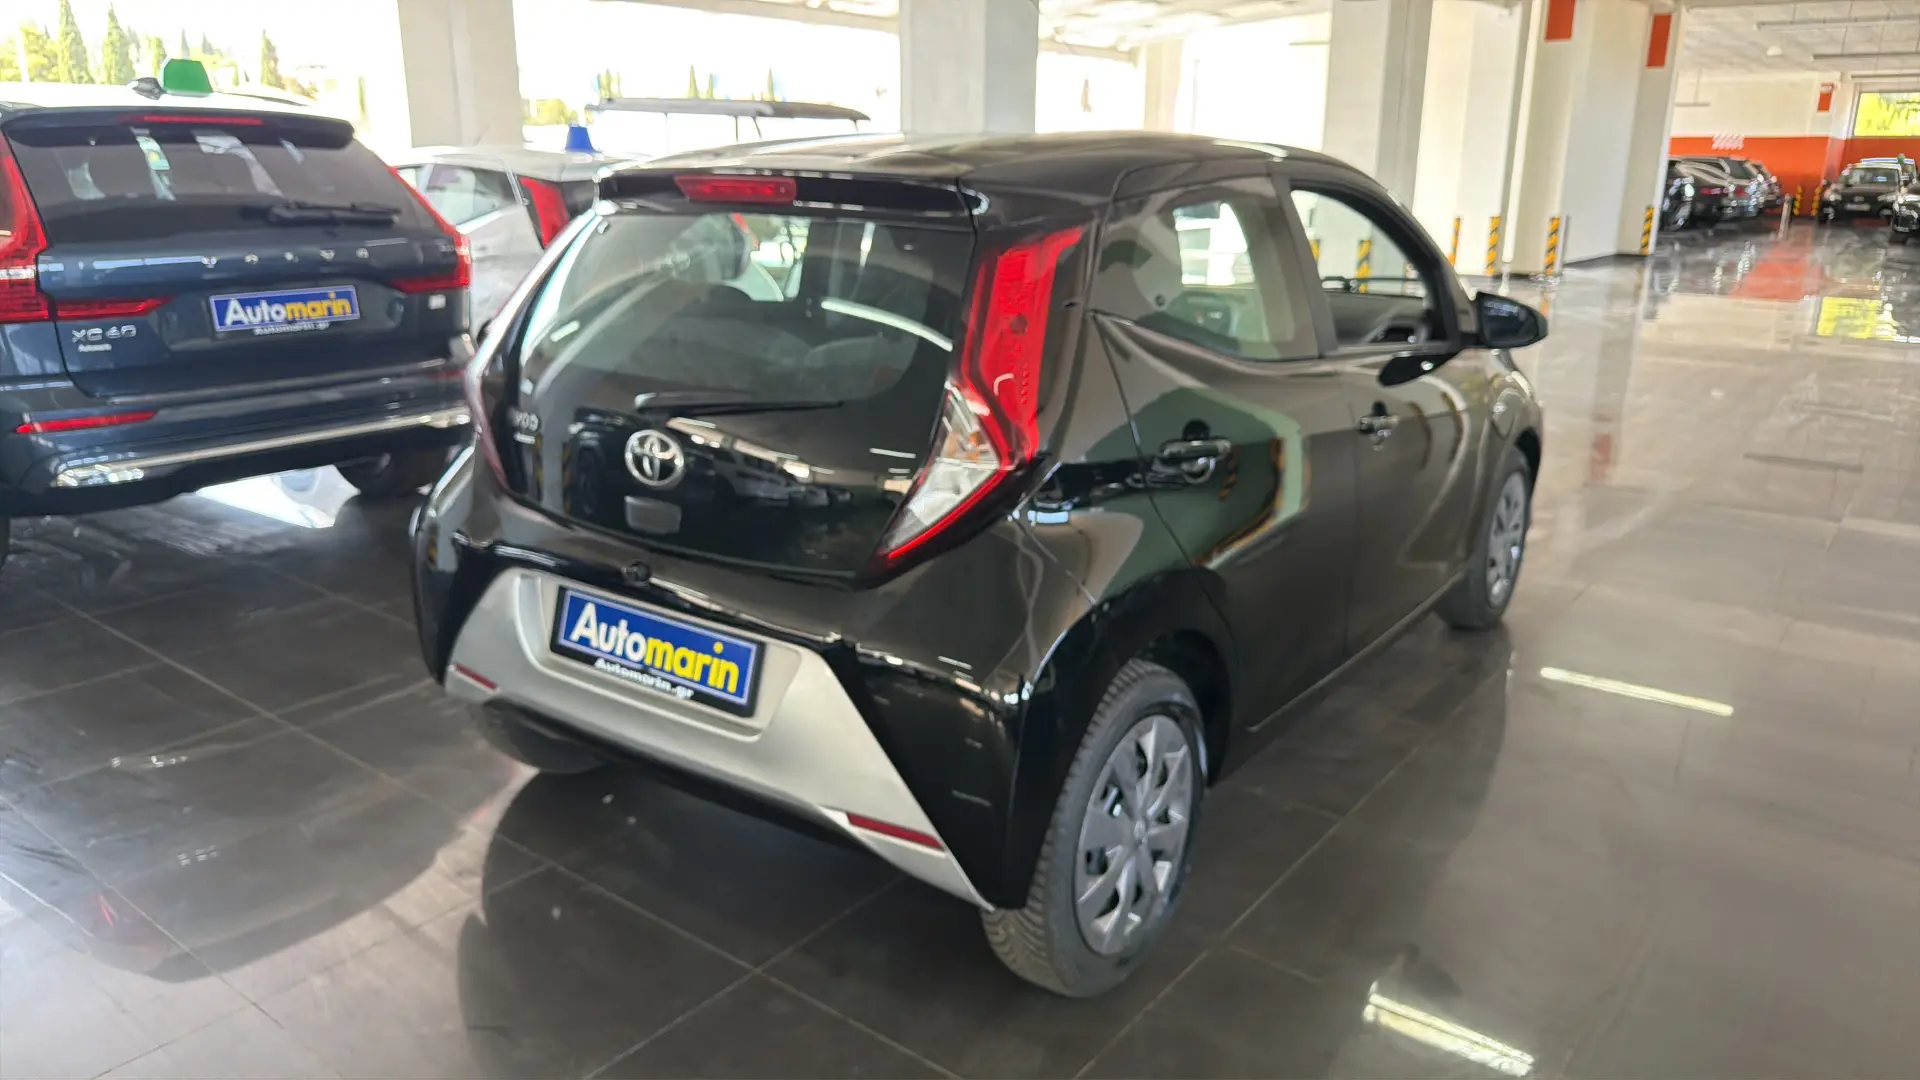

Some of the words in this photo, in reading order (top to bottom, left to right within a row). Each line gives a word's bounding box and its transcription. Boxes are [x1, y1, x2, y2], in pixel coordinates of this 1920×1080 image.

[224, 290, 352, 326] Automarin
[569, 602, 740, 694] Automarin
[594, 657, 695, 700] Automarin.gr
